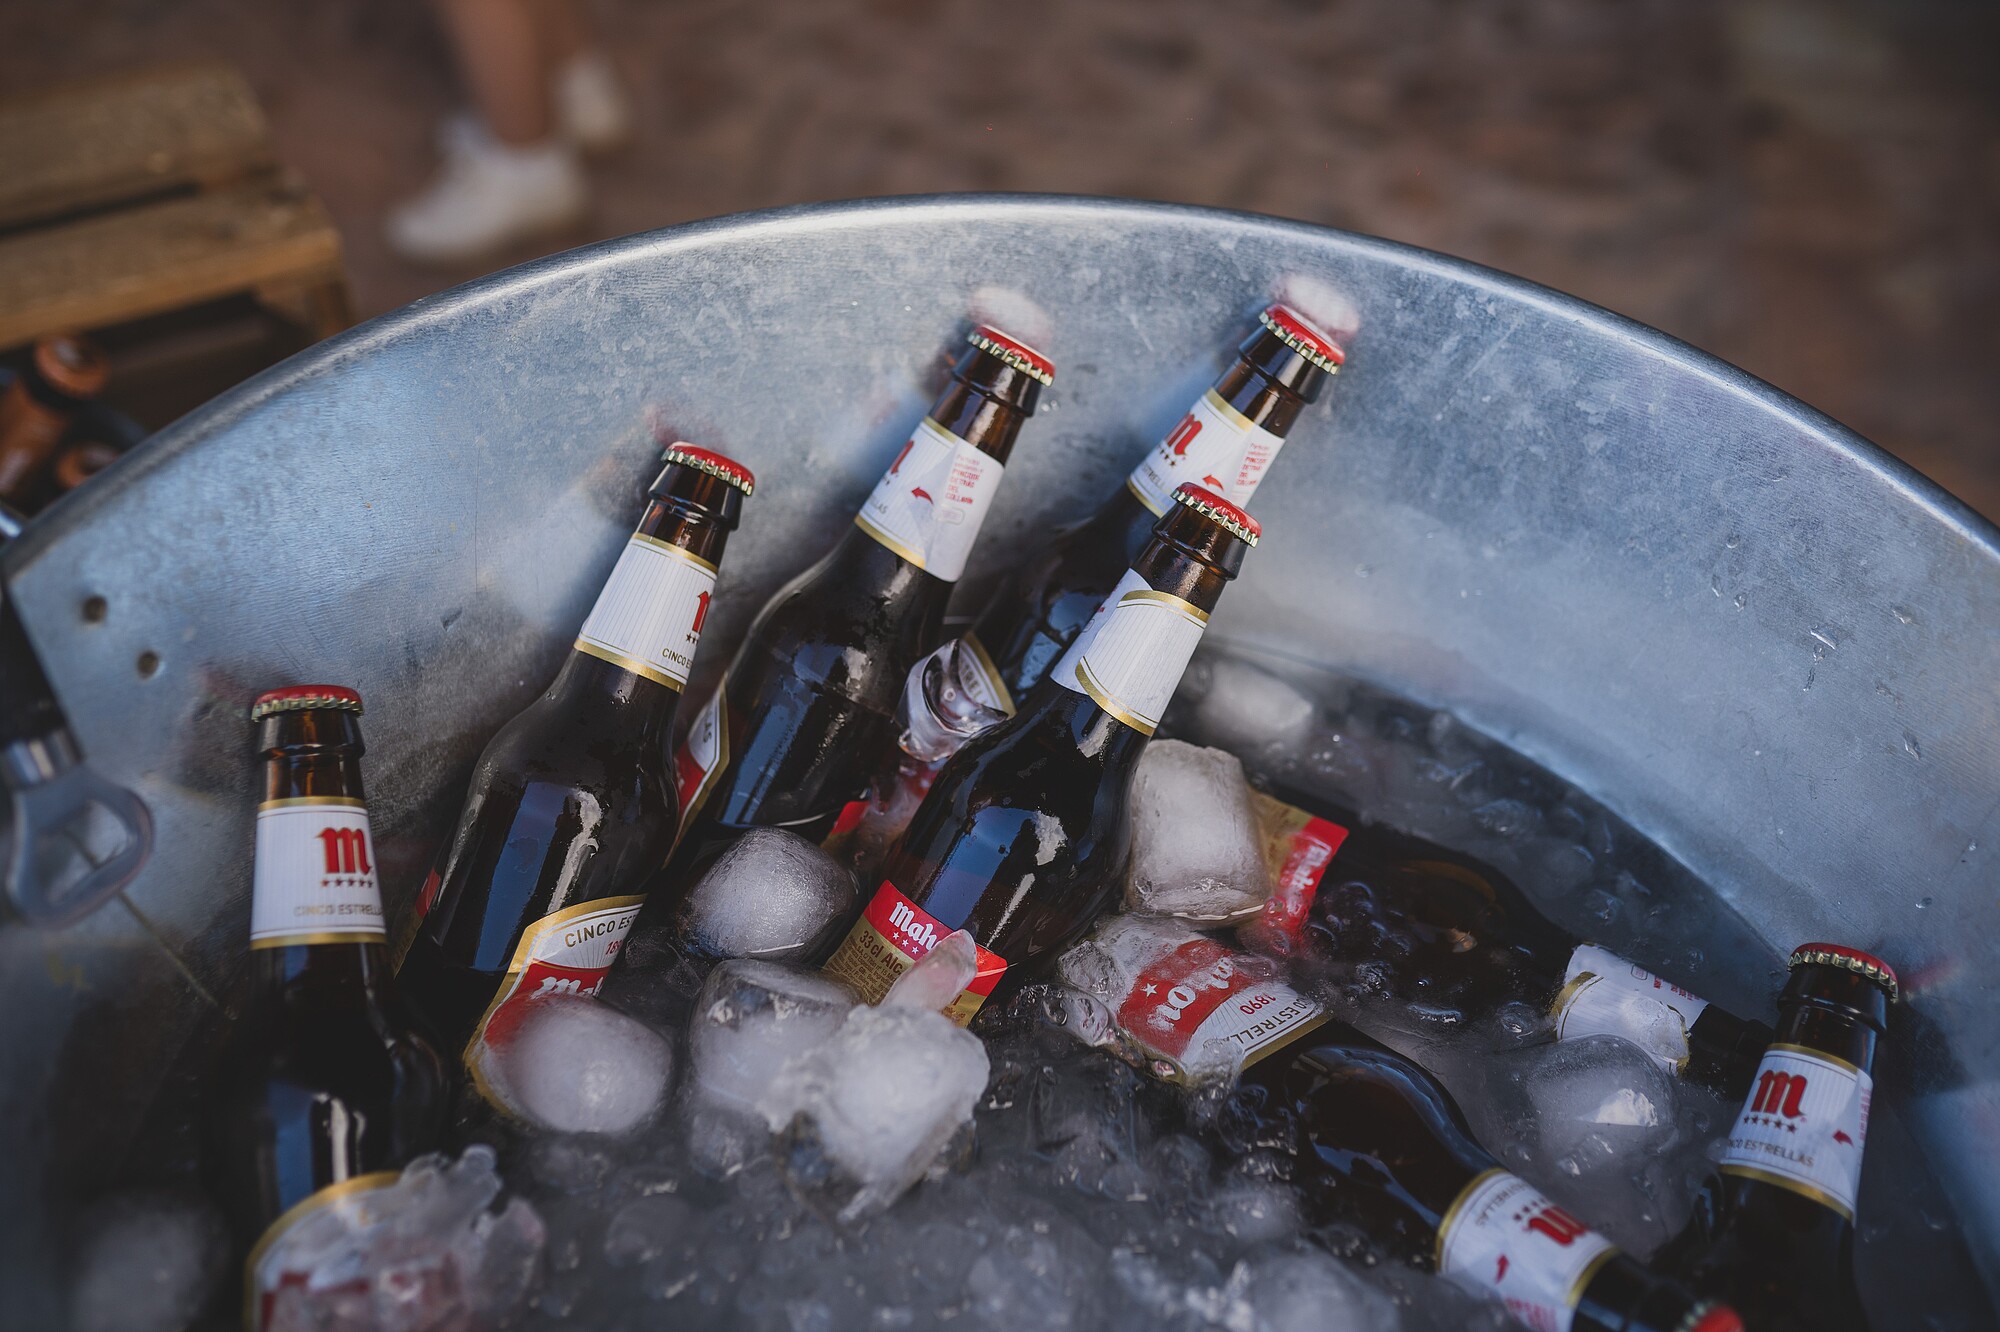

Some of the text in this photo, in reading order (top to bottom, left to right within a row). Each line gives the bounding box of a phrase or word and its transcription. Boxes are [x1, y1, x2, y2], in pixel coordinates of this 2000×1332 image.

[662, 648, 686, 664] CINCO
[564, 920, 616, 948] CINCO
[860, 930, 874, 949] 33
[870, 945, 884, 958] cl
[1240, 992, 1276, 1015] 1890
[1229, 1006, 1300, 1044] ESTRELL
[1744, 1139, 1815, 1168] ESTRELLAS
